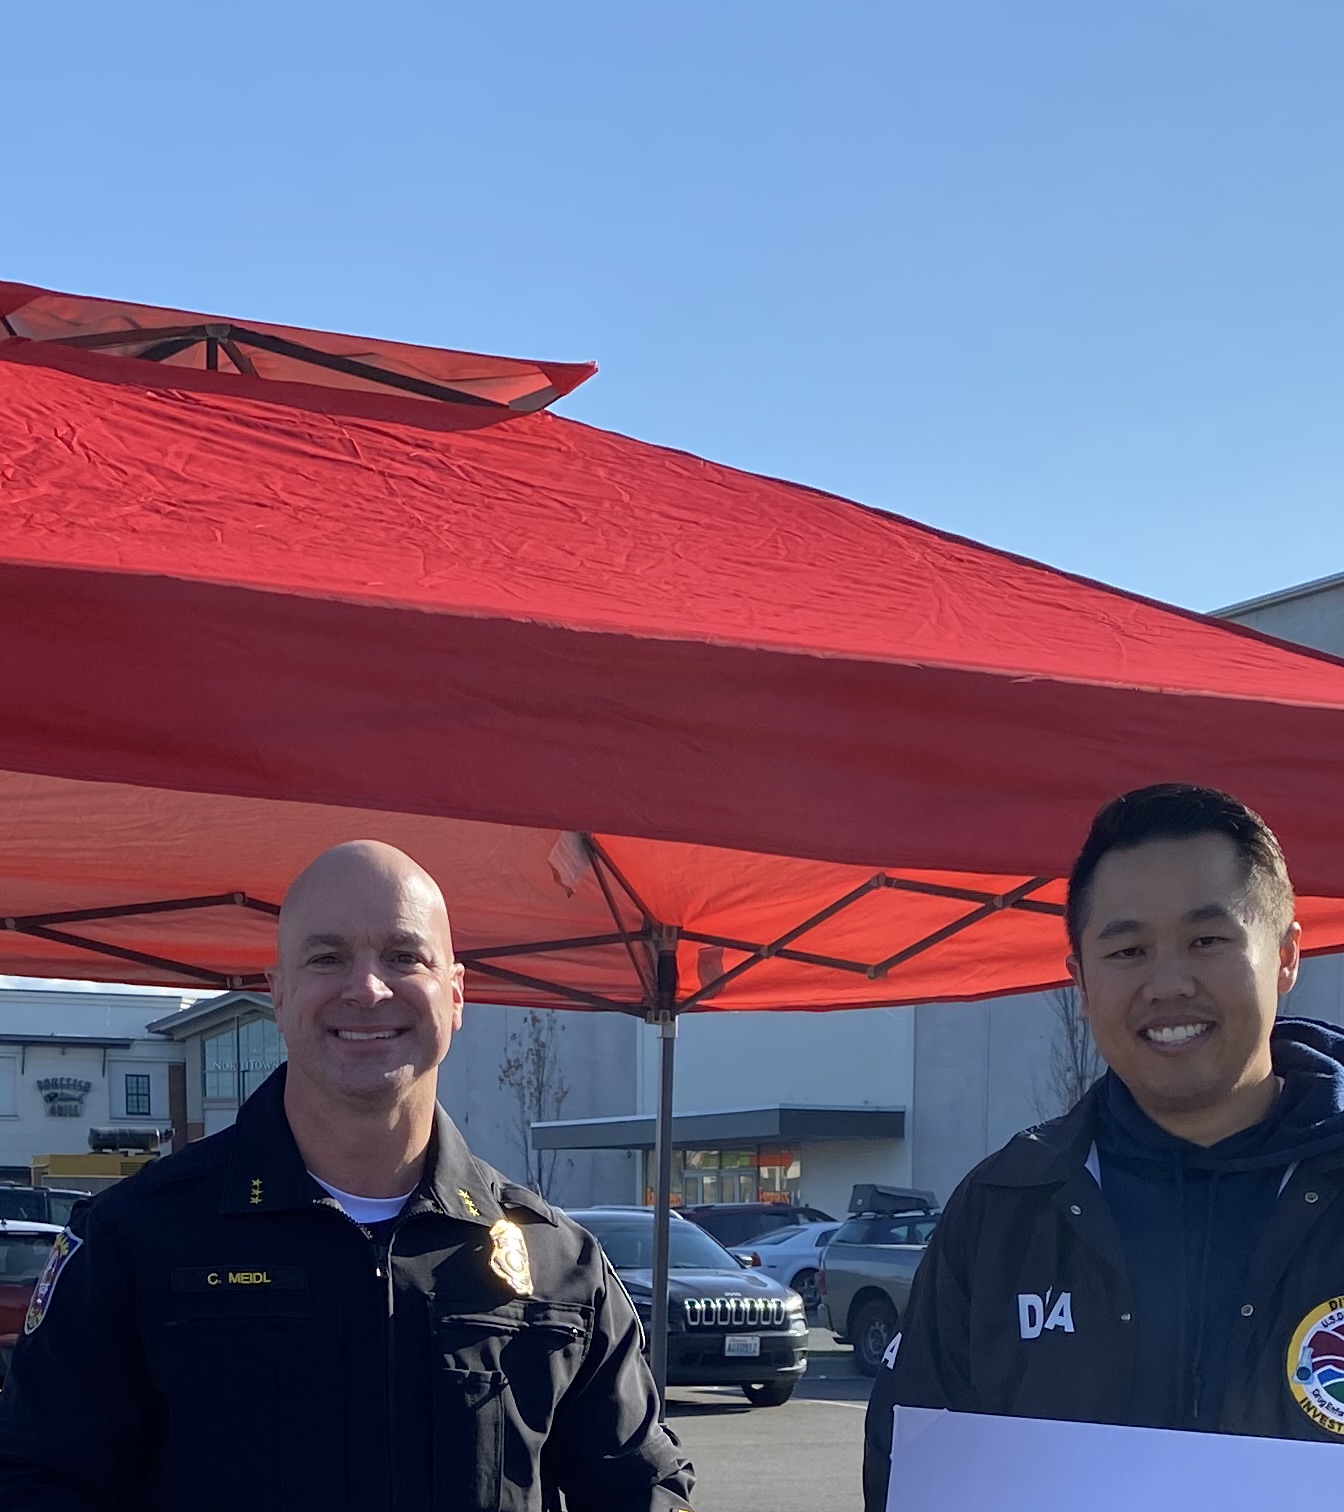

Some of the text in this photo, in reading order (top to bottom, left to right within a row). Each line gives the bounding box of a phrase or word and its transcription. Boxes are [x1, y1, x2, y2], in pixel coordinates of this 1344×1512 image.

[207, 1271, 272, 1285] C. MEIDL
[1018, 1286, 1075, 1339] DA
